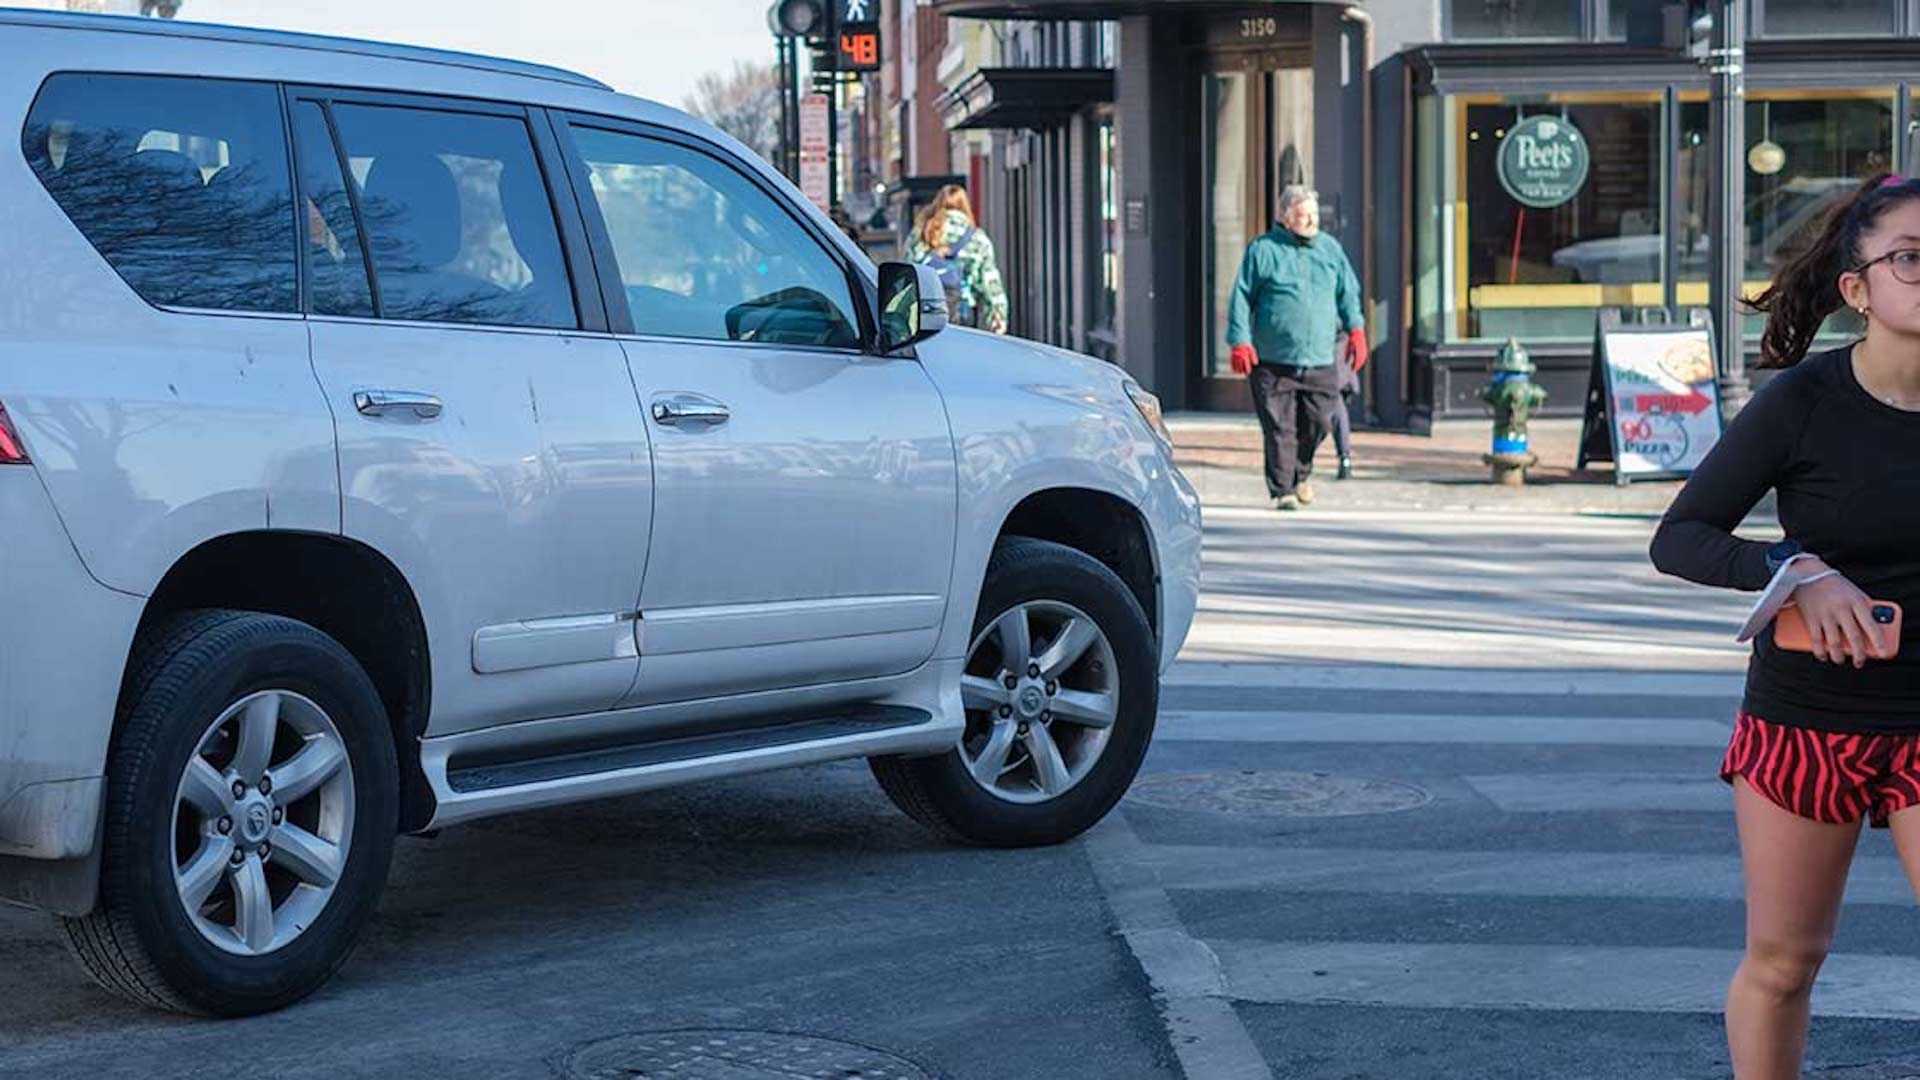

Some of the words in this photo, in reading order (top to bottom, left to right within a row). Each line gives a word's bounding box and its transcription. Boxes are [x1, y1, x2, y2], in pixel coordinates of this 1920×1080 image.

[1240, 17, 1276, 37] 3150
[841, 34, 878, 64] 48
[1621, 420, 1652, 441] 90
